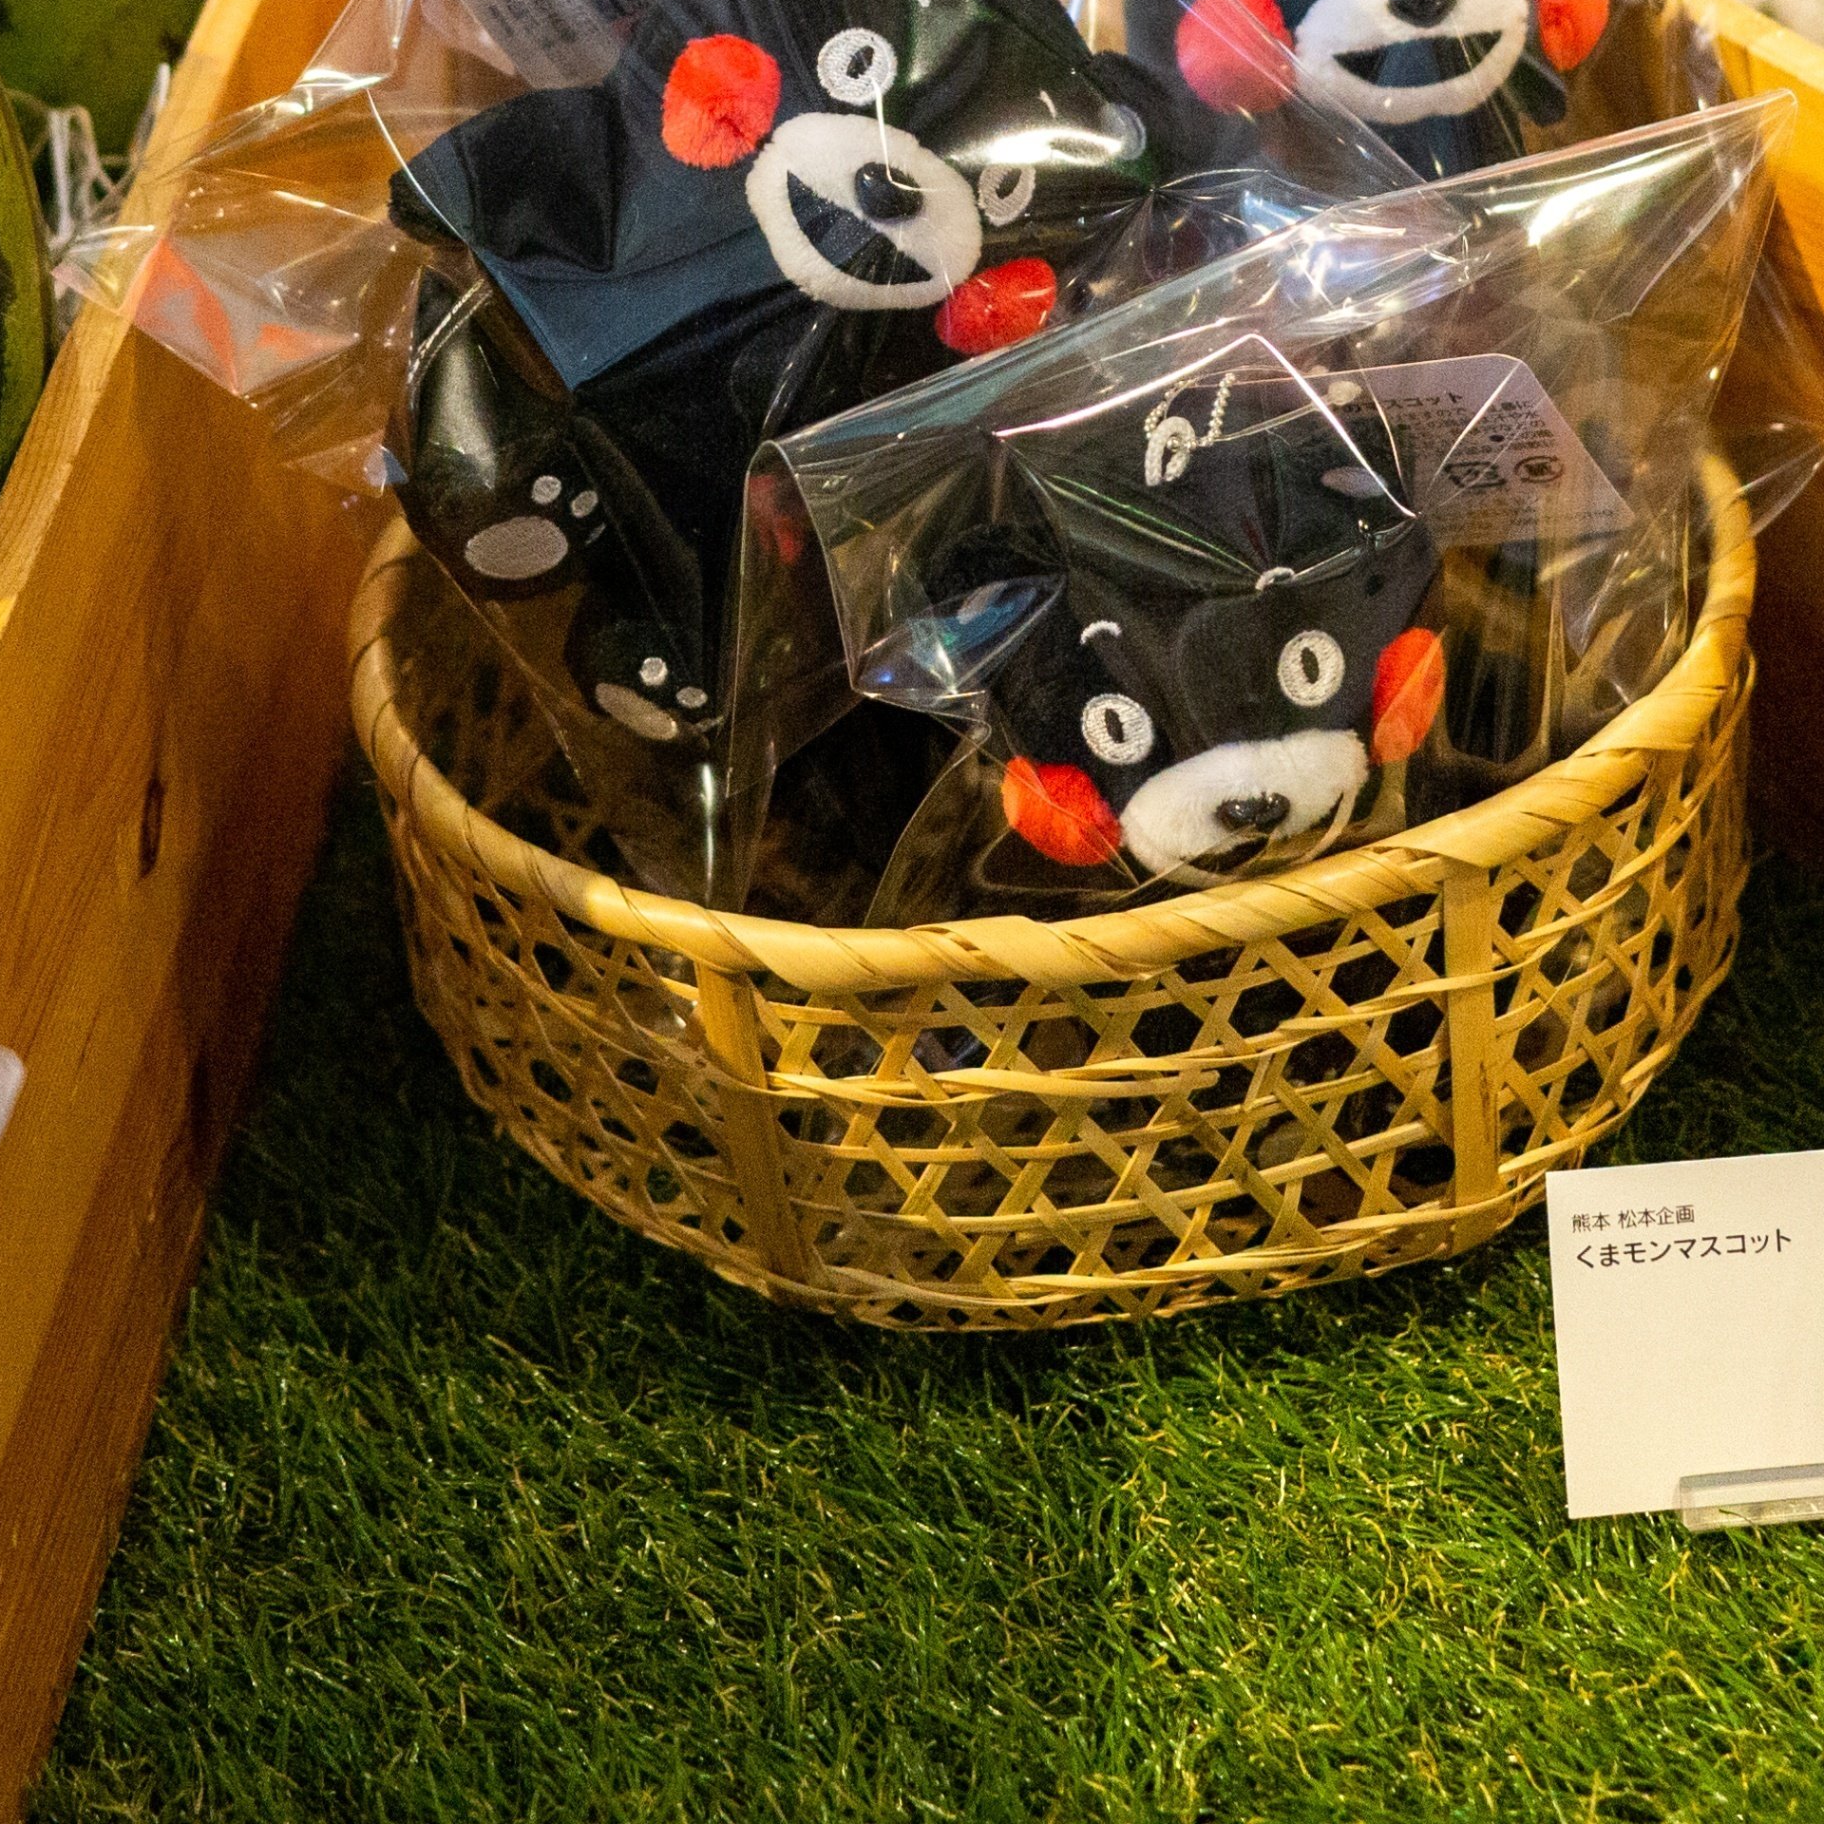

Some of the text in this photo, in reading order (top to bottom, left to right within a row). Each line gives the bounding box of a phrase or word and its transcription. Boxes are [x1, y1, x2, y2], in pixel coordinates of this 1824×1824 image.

[1571, 1204, 1695, 1234] 熊本 松本企画
[1576, 1228, 1791, 1269] くまモンマスコット
